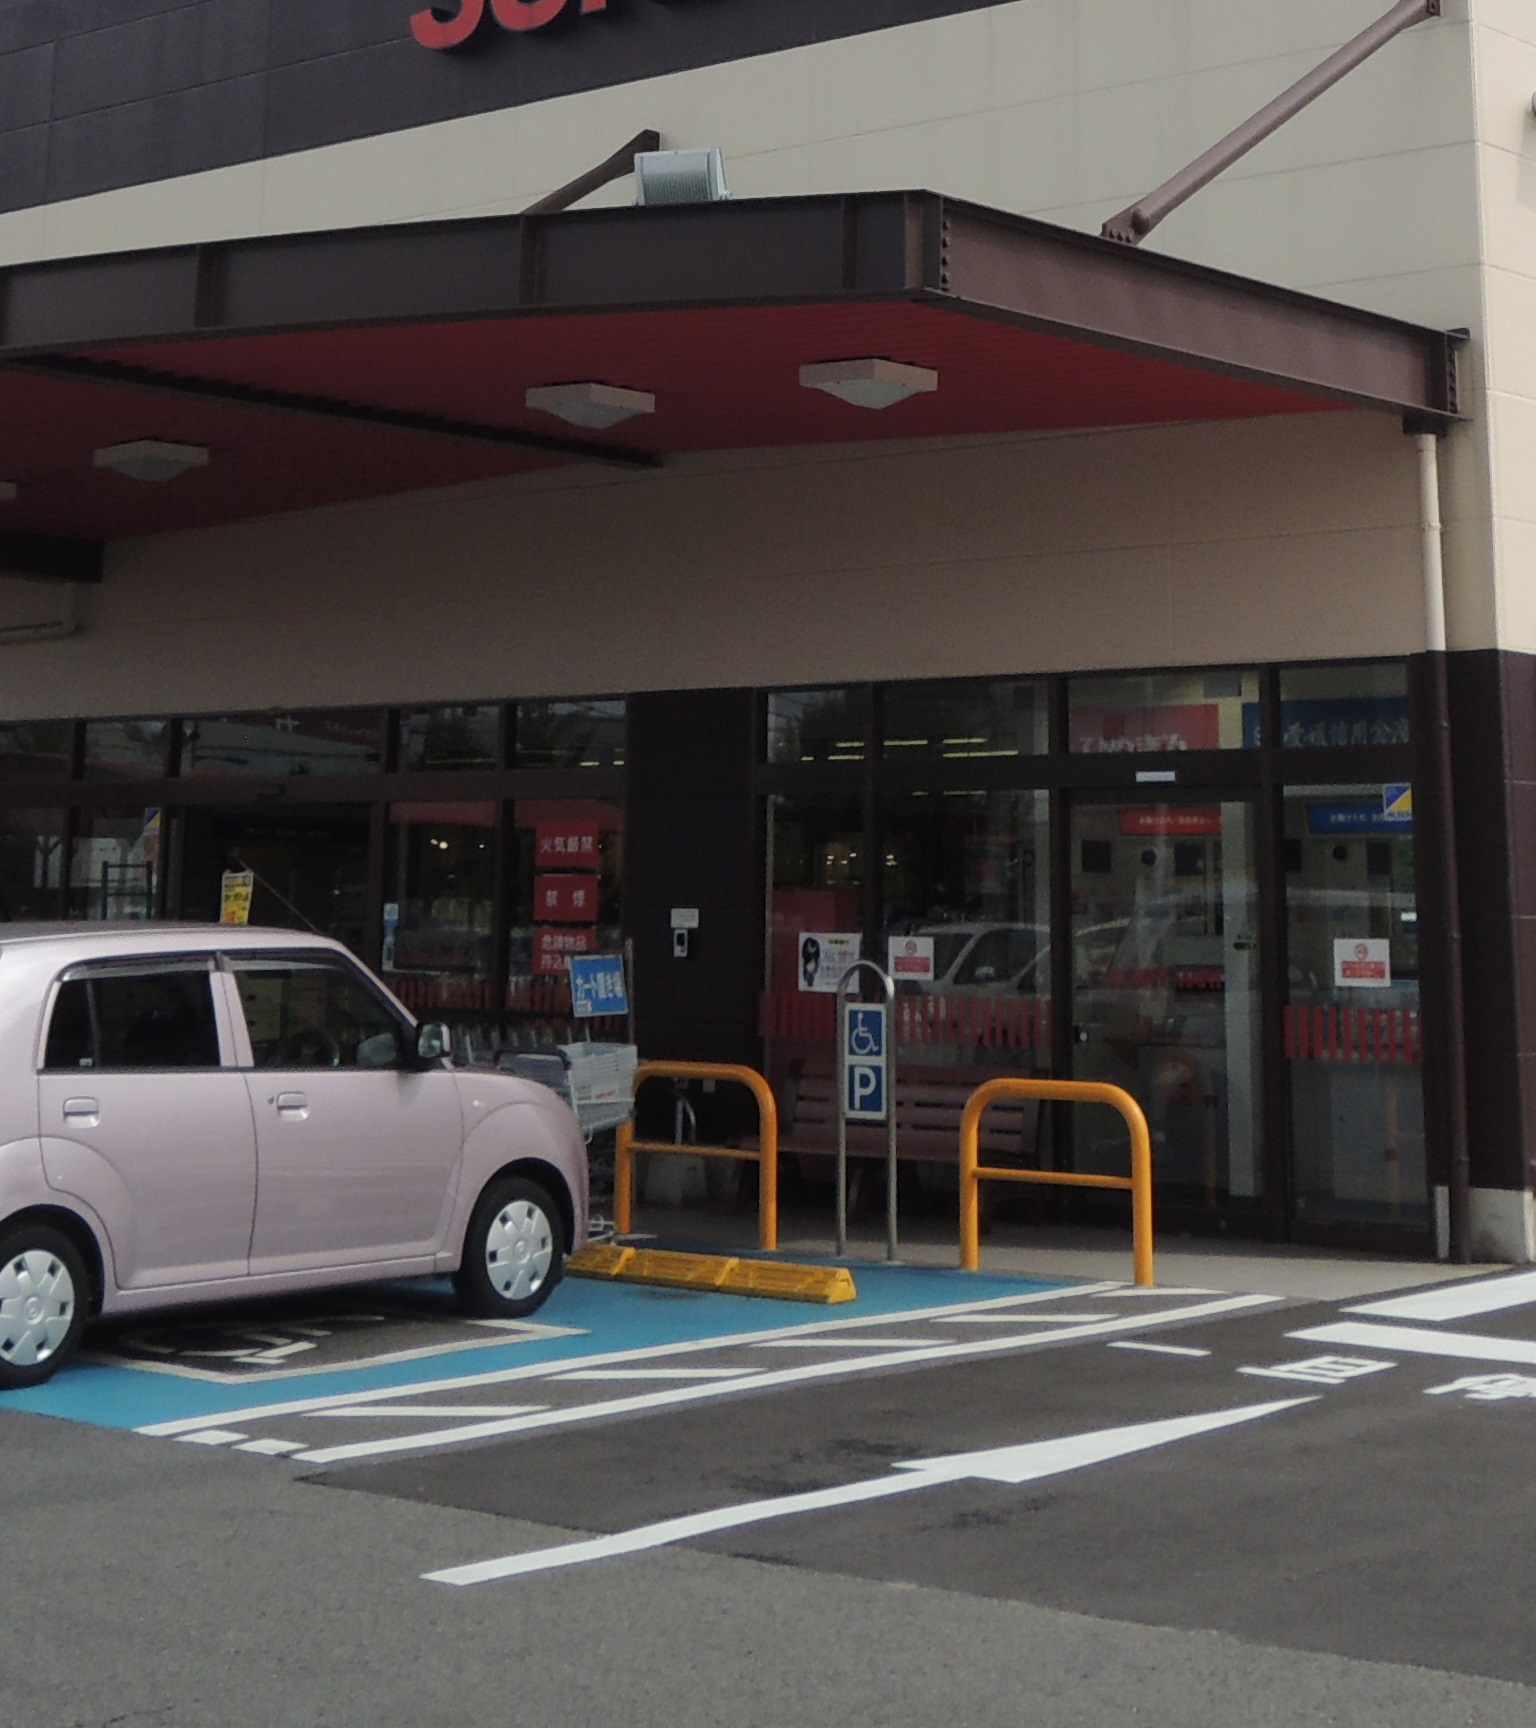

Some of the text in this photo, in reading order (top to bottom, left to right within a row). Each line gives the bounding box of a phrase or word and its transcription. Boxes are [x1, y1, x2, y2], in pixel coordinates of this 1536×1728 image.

[540, 836, 593, 853] 火気厳禁
[854, 1067, 877, 1110] P
